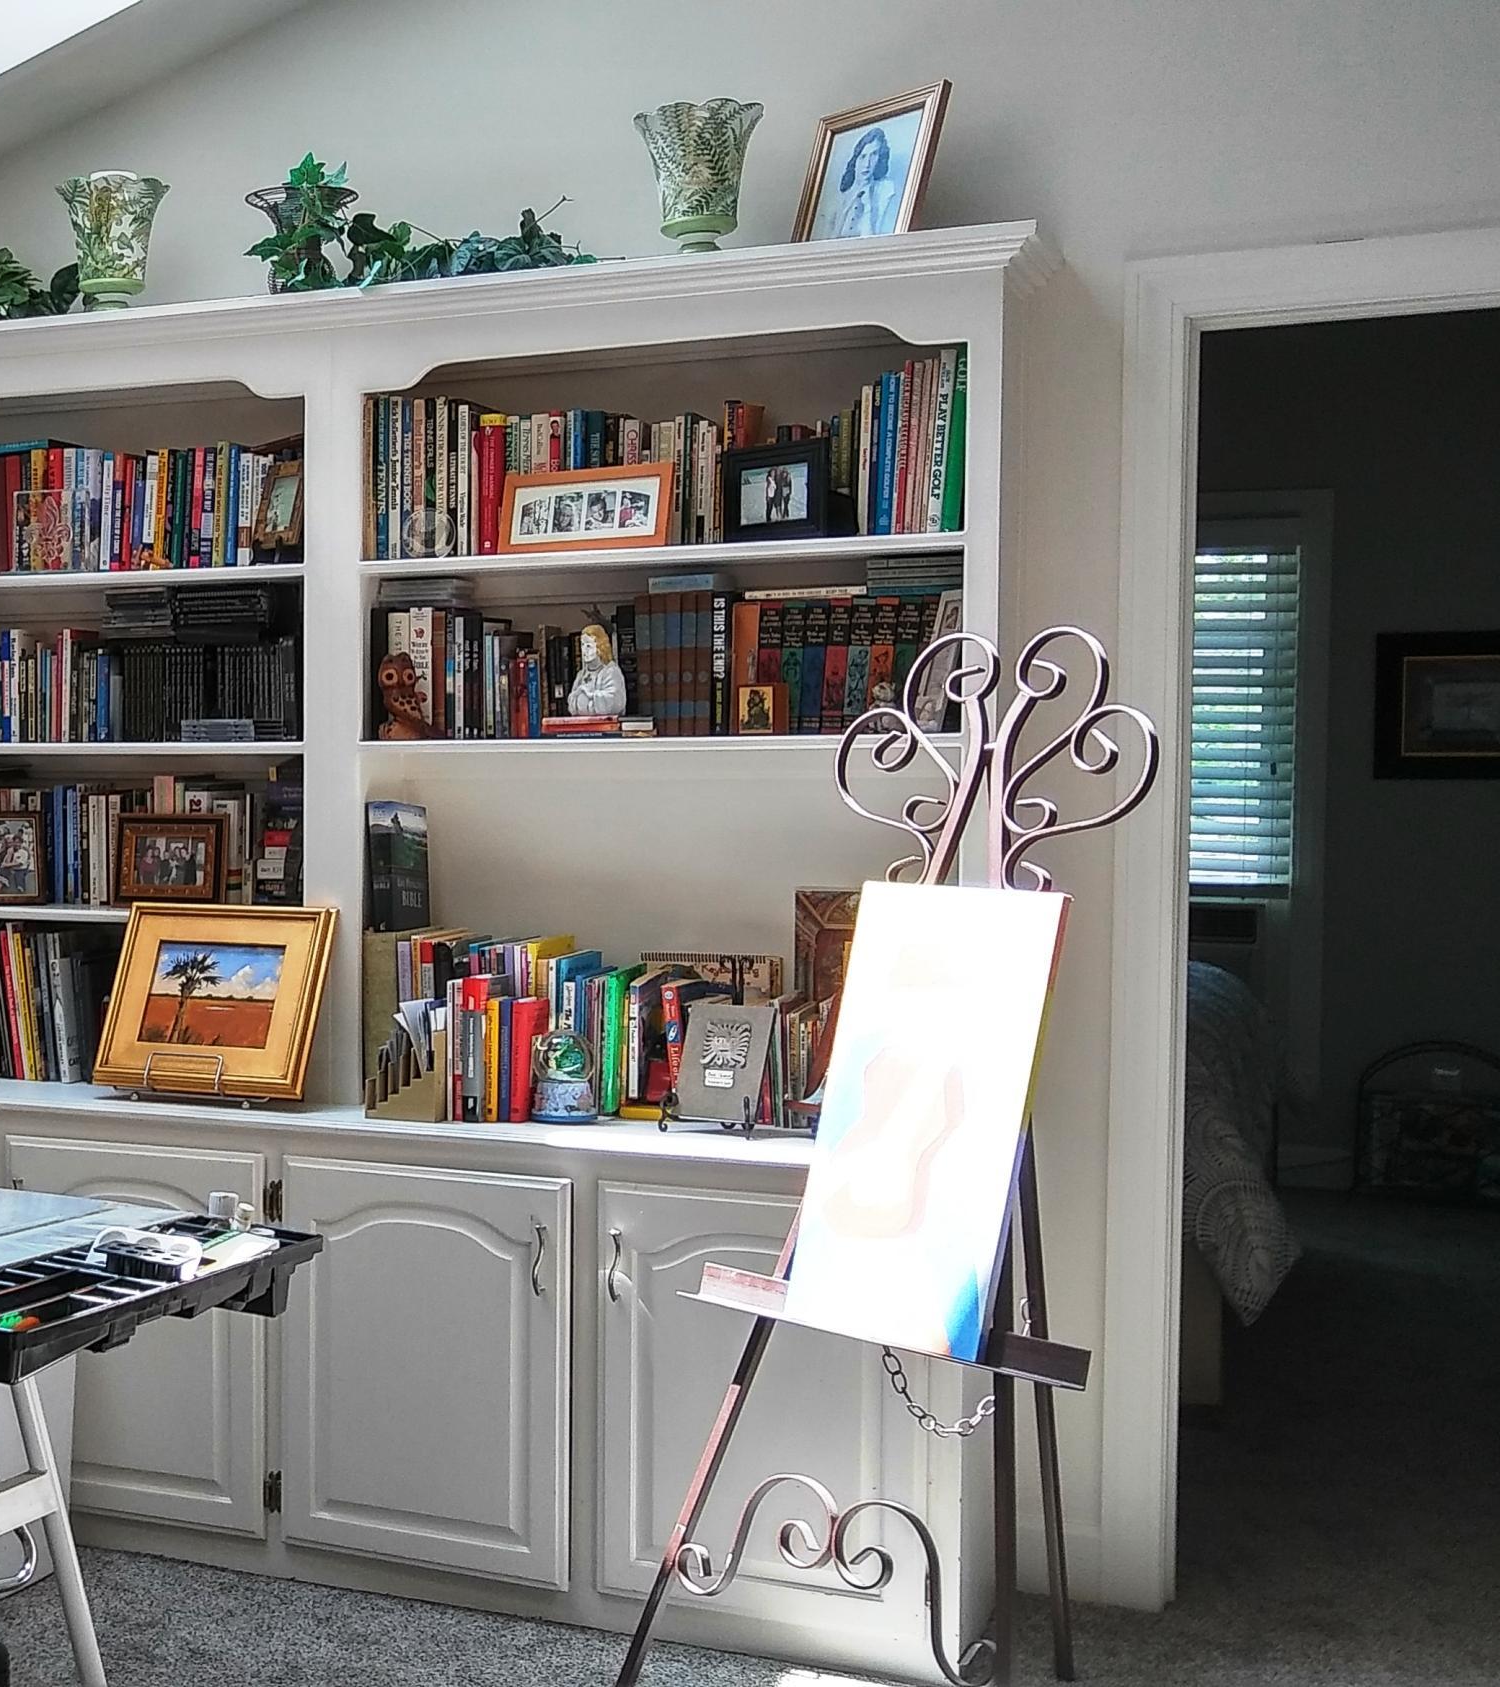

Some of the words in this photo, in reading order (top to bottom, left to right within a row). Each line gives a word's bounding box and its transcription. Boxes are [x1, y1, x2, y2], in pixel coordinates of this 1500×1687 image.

[956, 358, 967, 392] GOLF
[937, 393, 949, 422] PLAY
[404, 432, 412, 451] THE
[933, 424, 946, 467] BETTER
[404, 453, 412, 484] TENNIS
[377, 462, 386, 514] TENNIS
[931, 468, 943, 500] GOLF
[391, 485, 399, 510] Tennis
[404, 486, 412, 512] BOOK
[713, 598, 725, 607] IS
[713, 610, 725, 632] THIS
[713, 634, 725, 651] THE
[713, 653, 725, 678] END?
[670, 1047, 680, 1065] Life
